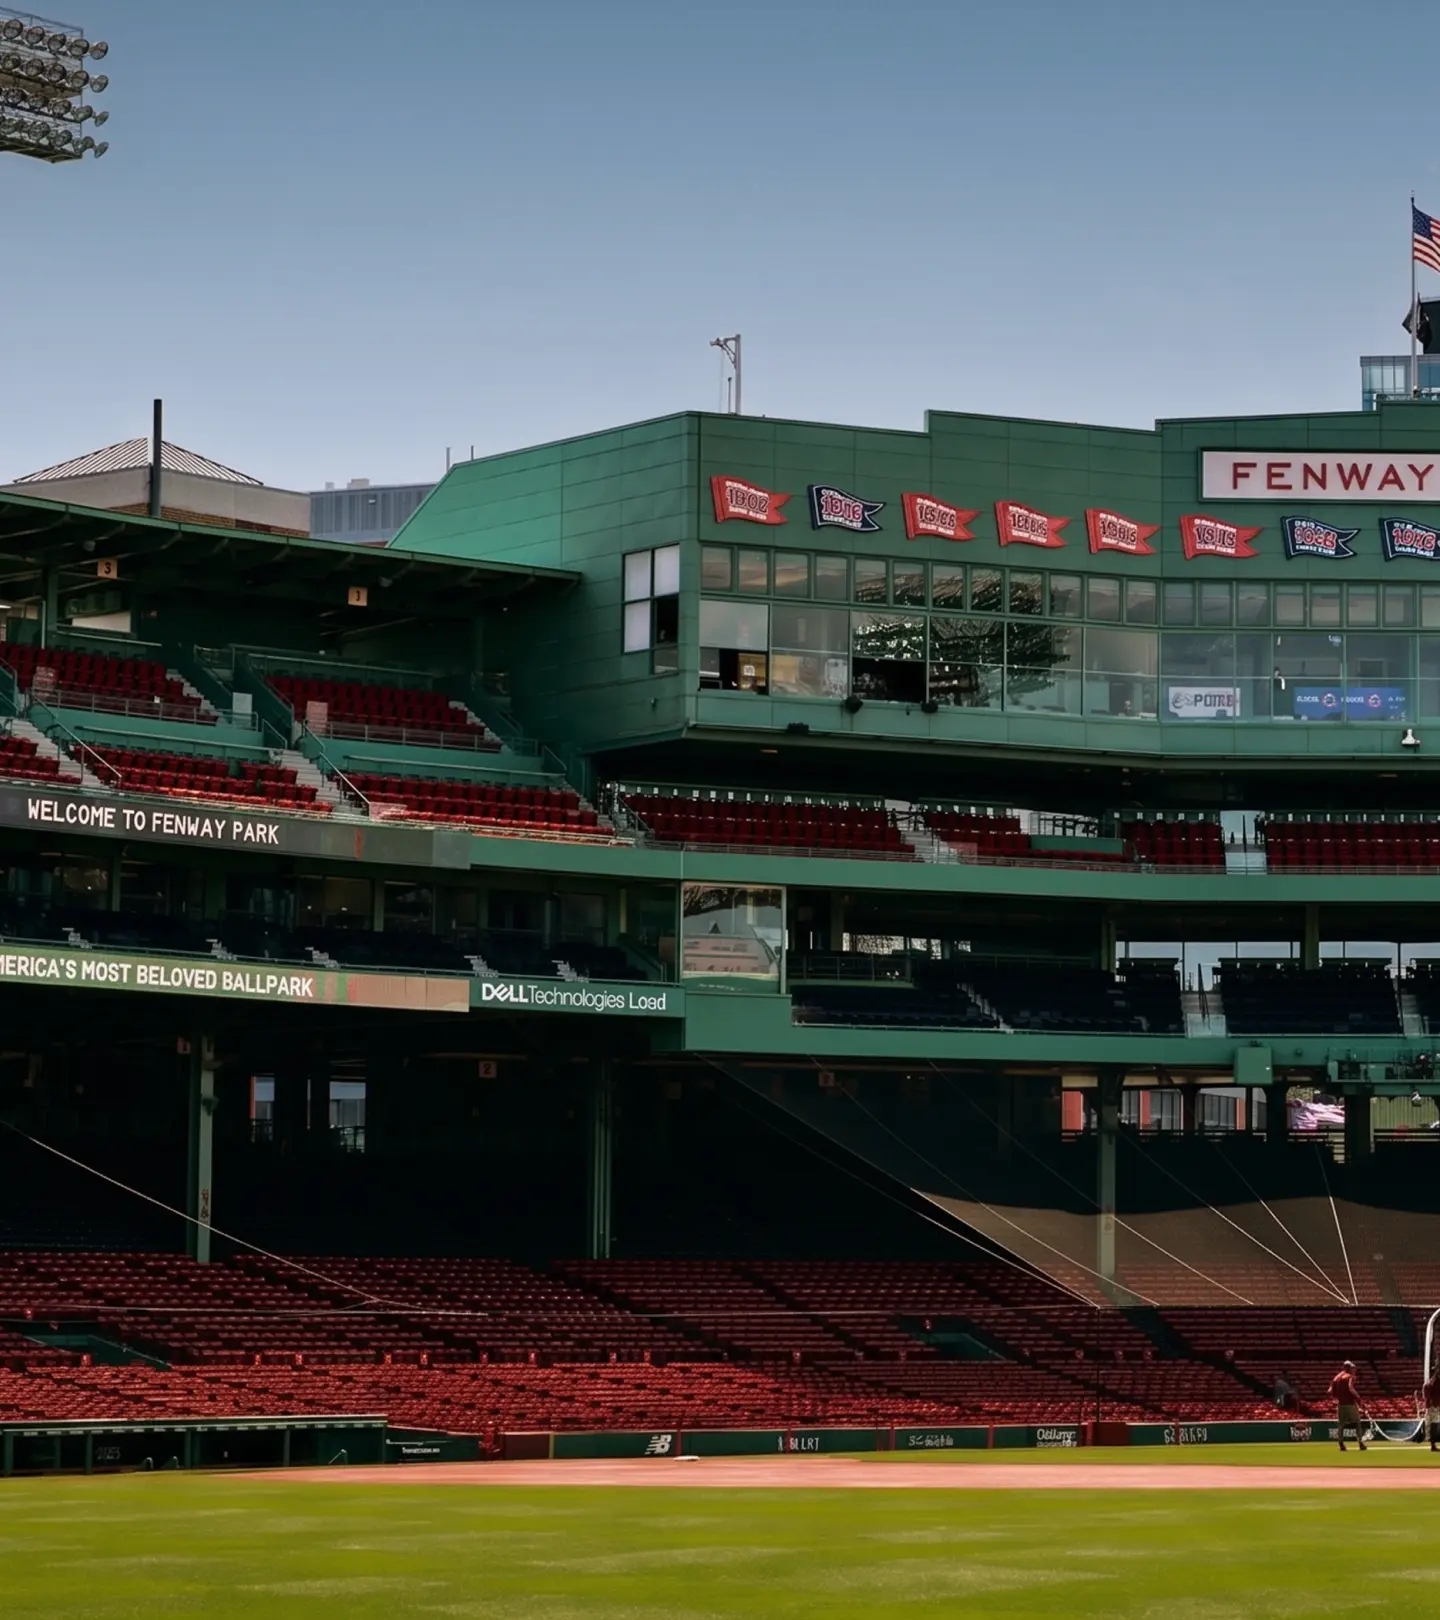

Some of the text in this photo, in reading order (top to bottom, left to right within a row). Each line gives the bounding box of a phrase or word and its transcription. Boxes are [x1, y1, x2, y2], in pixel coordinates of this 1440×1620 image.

[1232, 462, 1435, 491] FENWAY
[27, 798, 279, 845] WELCOME TO FENWAY PARK
[81, 960, 132, 984] MOST
[136, 964, 217, 990] BELOVED
[222, 970, 314, 998] BALLPARK
